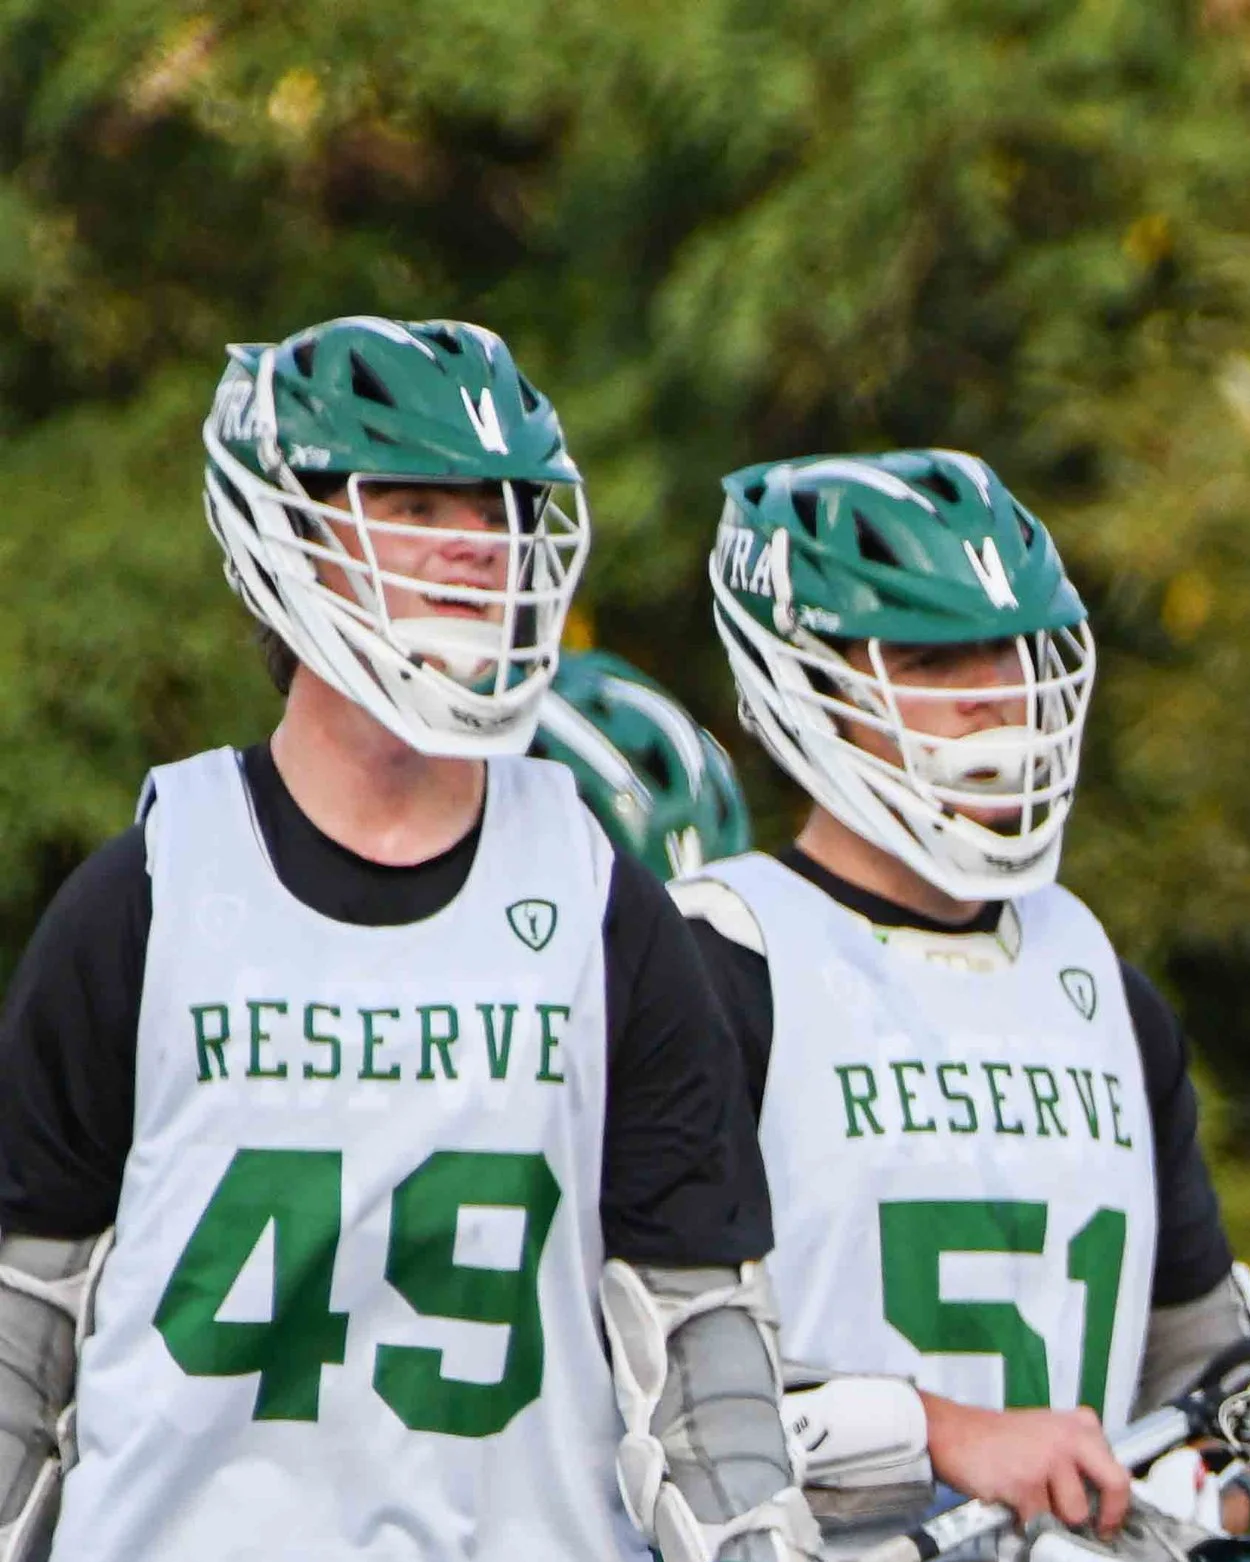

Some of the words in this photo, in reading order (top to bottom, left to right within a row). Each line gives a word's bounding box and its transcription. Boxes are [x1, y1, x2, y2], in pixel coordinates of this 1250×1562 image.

[189, 999, 571, 1082] RESERVE
[833, 1060, 1132, 1149] RESERVE
[152, 1148, 562, 1438] 49
[879, 1201, 1126, 1426] 51
